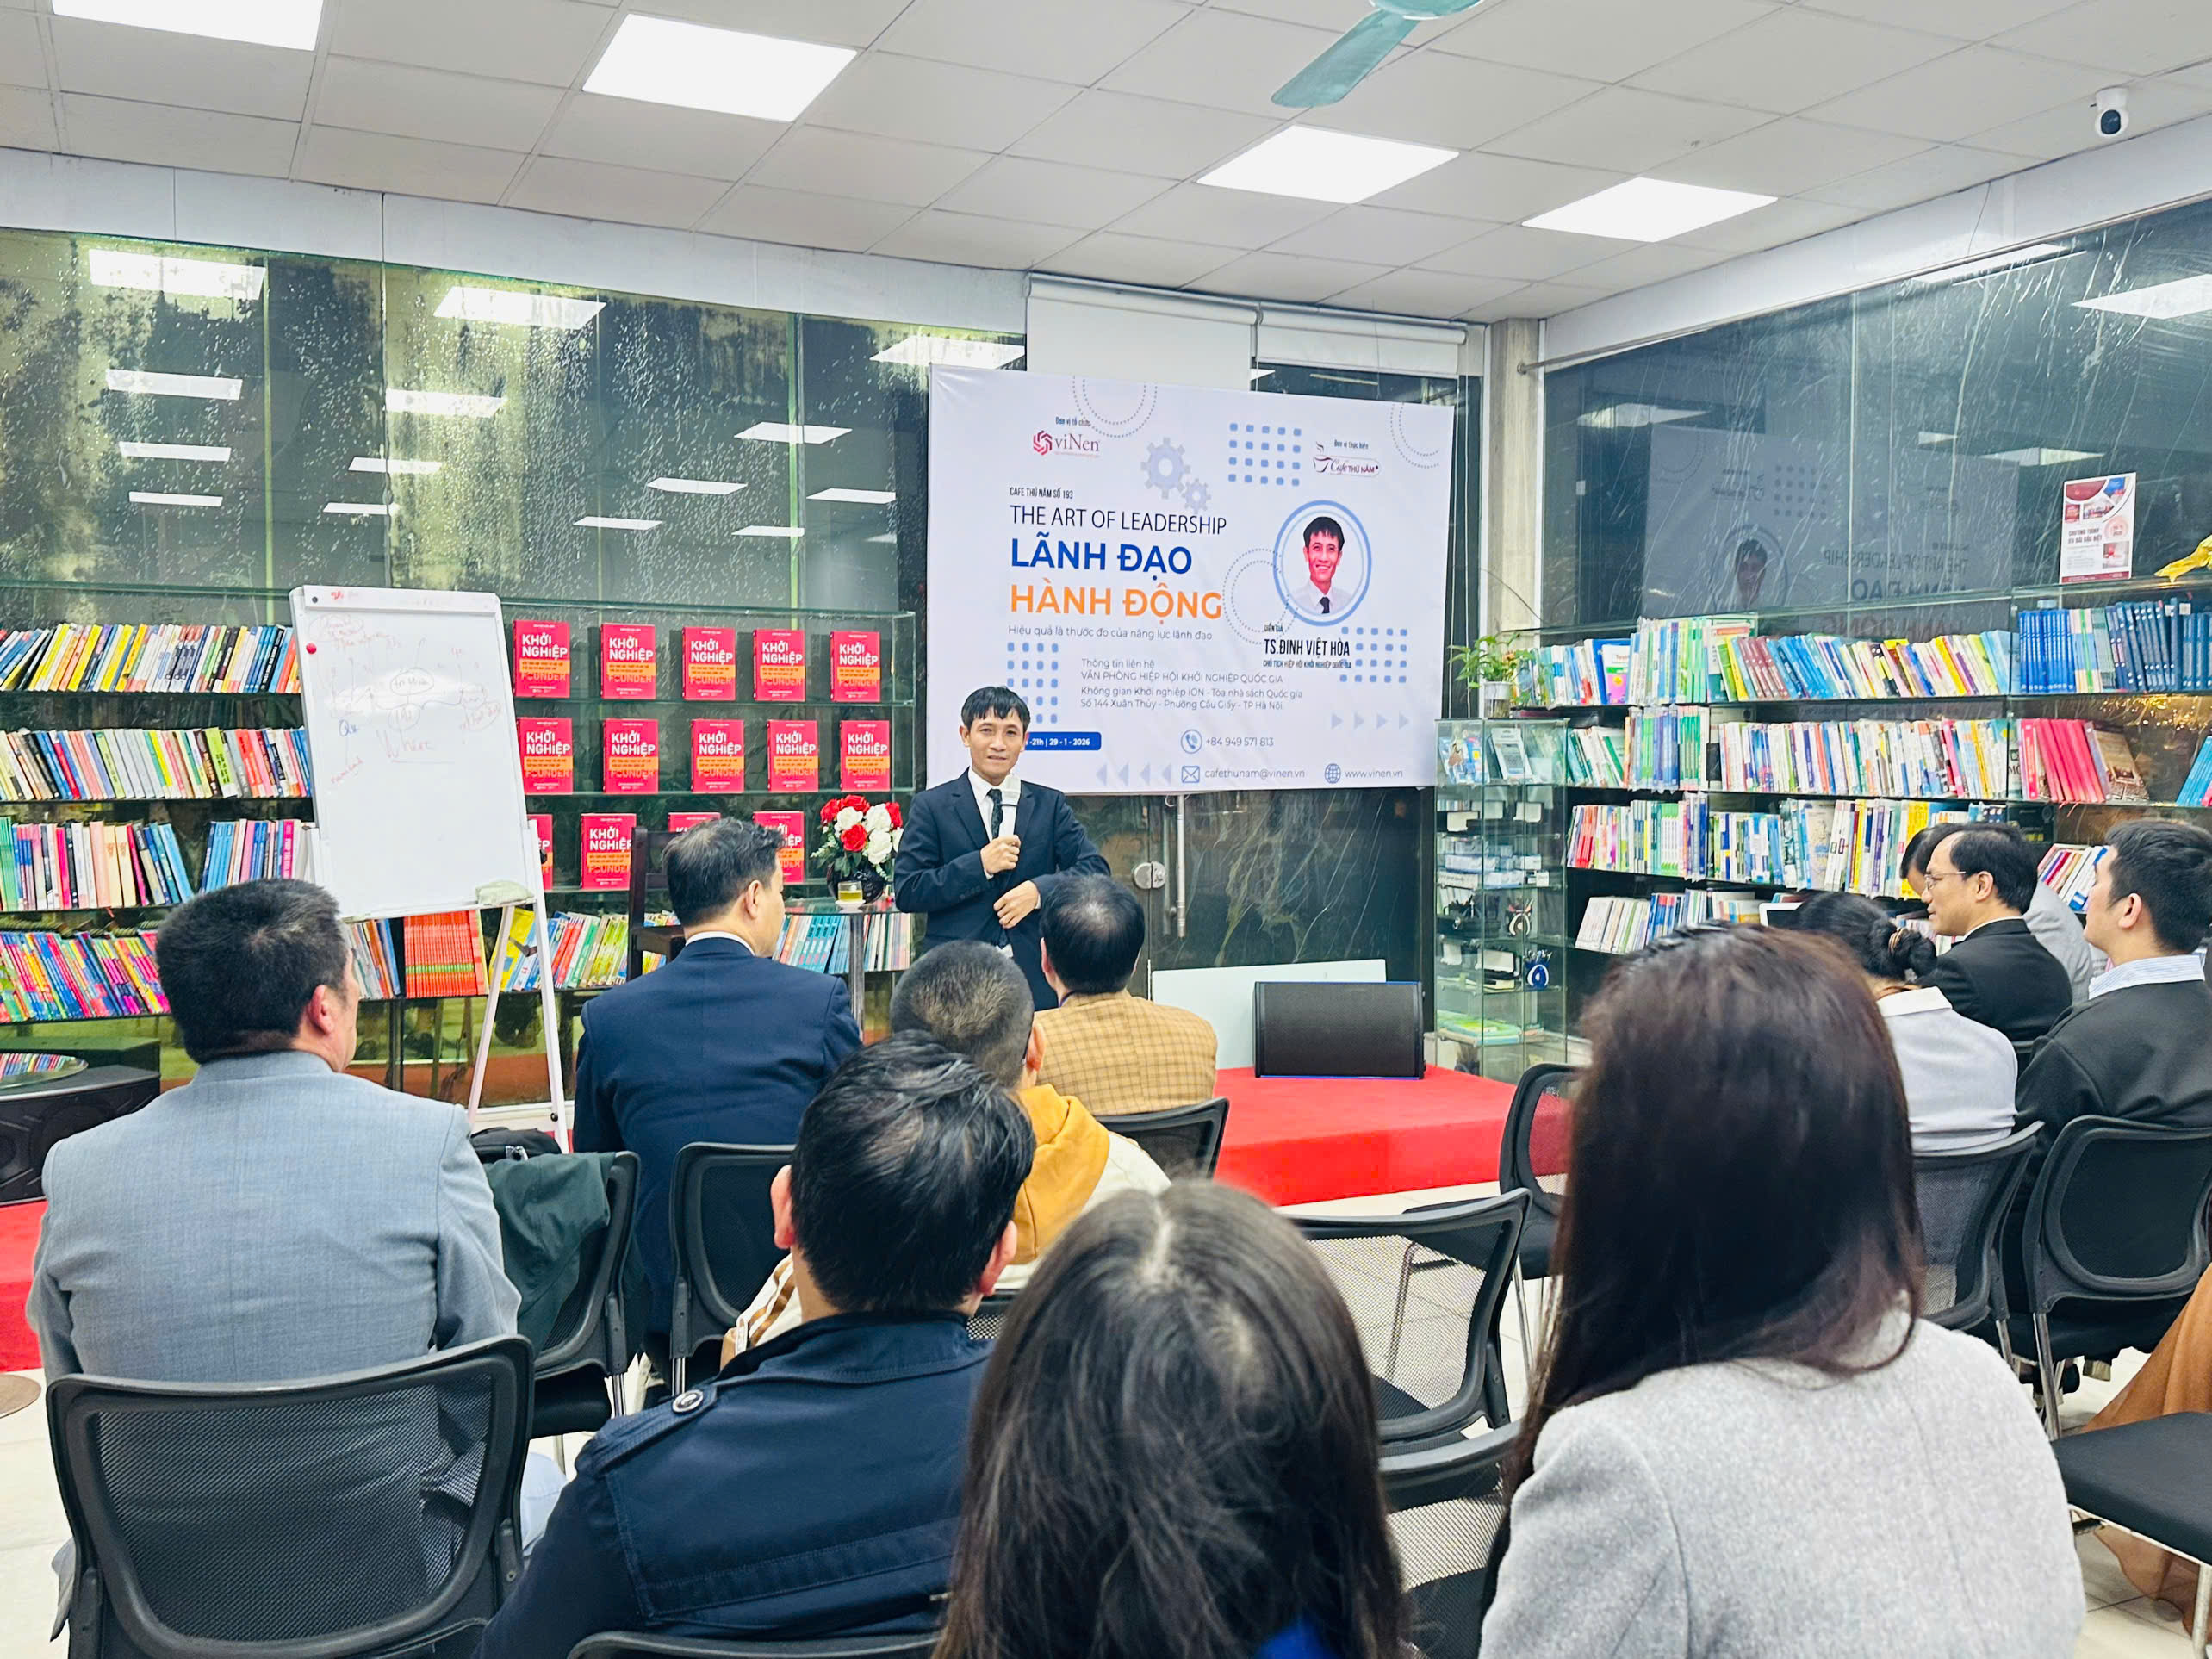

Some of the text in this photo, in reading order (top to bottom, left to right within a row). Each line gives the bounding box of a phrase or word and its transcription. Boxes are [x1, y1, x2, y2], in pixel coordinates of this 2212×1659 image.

[1054, 433, 1099, 451] viNen
[1010, 486, 1025, 496] CAFE
[1053, 487, 1061, 498] SỐ
[1063, 489, 1073, 499] 193
[1010, 505, 1227, 534] THE ART OF LEADERSHIP
[1011, 531, 1192, 581] LÃNH ĐẠO
[1011, 577, 1222, 625] HÀNH ĐỘNG
[1008, 625, 1031, 636] Hiệu
[1055, 626, 1063, 636] là
[1096, 627, 1109, 637] đo
[522, 632, 551, 646] KHỞI
[609, 636, 637, 649] KHỞI
[691, 638, 718, 651] KHỞI
[762, 640, 789, 653] KHỞI
[839, 642, 865, 655] KHỞI
[1306, 637, 1327, 659] VIỆT
[1330, 637, 1350, 656] HÒA
[1082, 658, 1109, 669] Thông
[1112, 659, 1123, 668] tin
[1126, 659, 1141, 668] liên
[1081, 669, 1101, 680] VĂN
[1103, 670, 1137, 680] PHÒNG
[1181, 672, 1202, 682] KHỞI
[1240, 672, 1267, 684] QUỐC
[1269, 674, 1283, 683] GIA
[1081, 687, 1109, 697] Không
[1112, 687, 1131, 697] gian
[1228, 688, 1244, 697] nhà
[1246, 689, 1264, 698] sách
[1266, 688, 1288, 699] Quốc
[1290, 691, 1302, 699] gia
[1081, 698, 1092, 707] Số
[1094, 699, 1109, 707] 144
[1111, 699, 1133, 708] Xuân
[1255, 700, 1266, 709] Hà
[526, 729, 556, 743] KHỞI
[612, 730, 641, 743] KHỞI
[699, 730, 727, 743] KHỞI
[776, 730, 802, 743] KHỞI
[848, 730, 873, 744] KHỞI
[1206, 737, 1274, 747] +84 949 571 813
[1204, 768, 1305, 780] cafethunam@vinen.vn
[1345, 769, 1403, 779] www.vinen.vn
[589, 826, 618, 840] KHỞI
